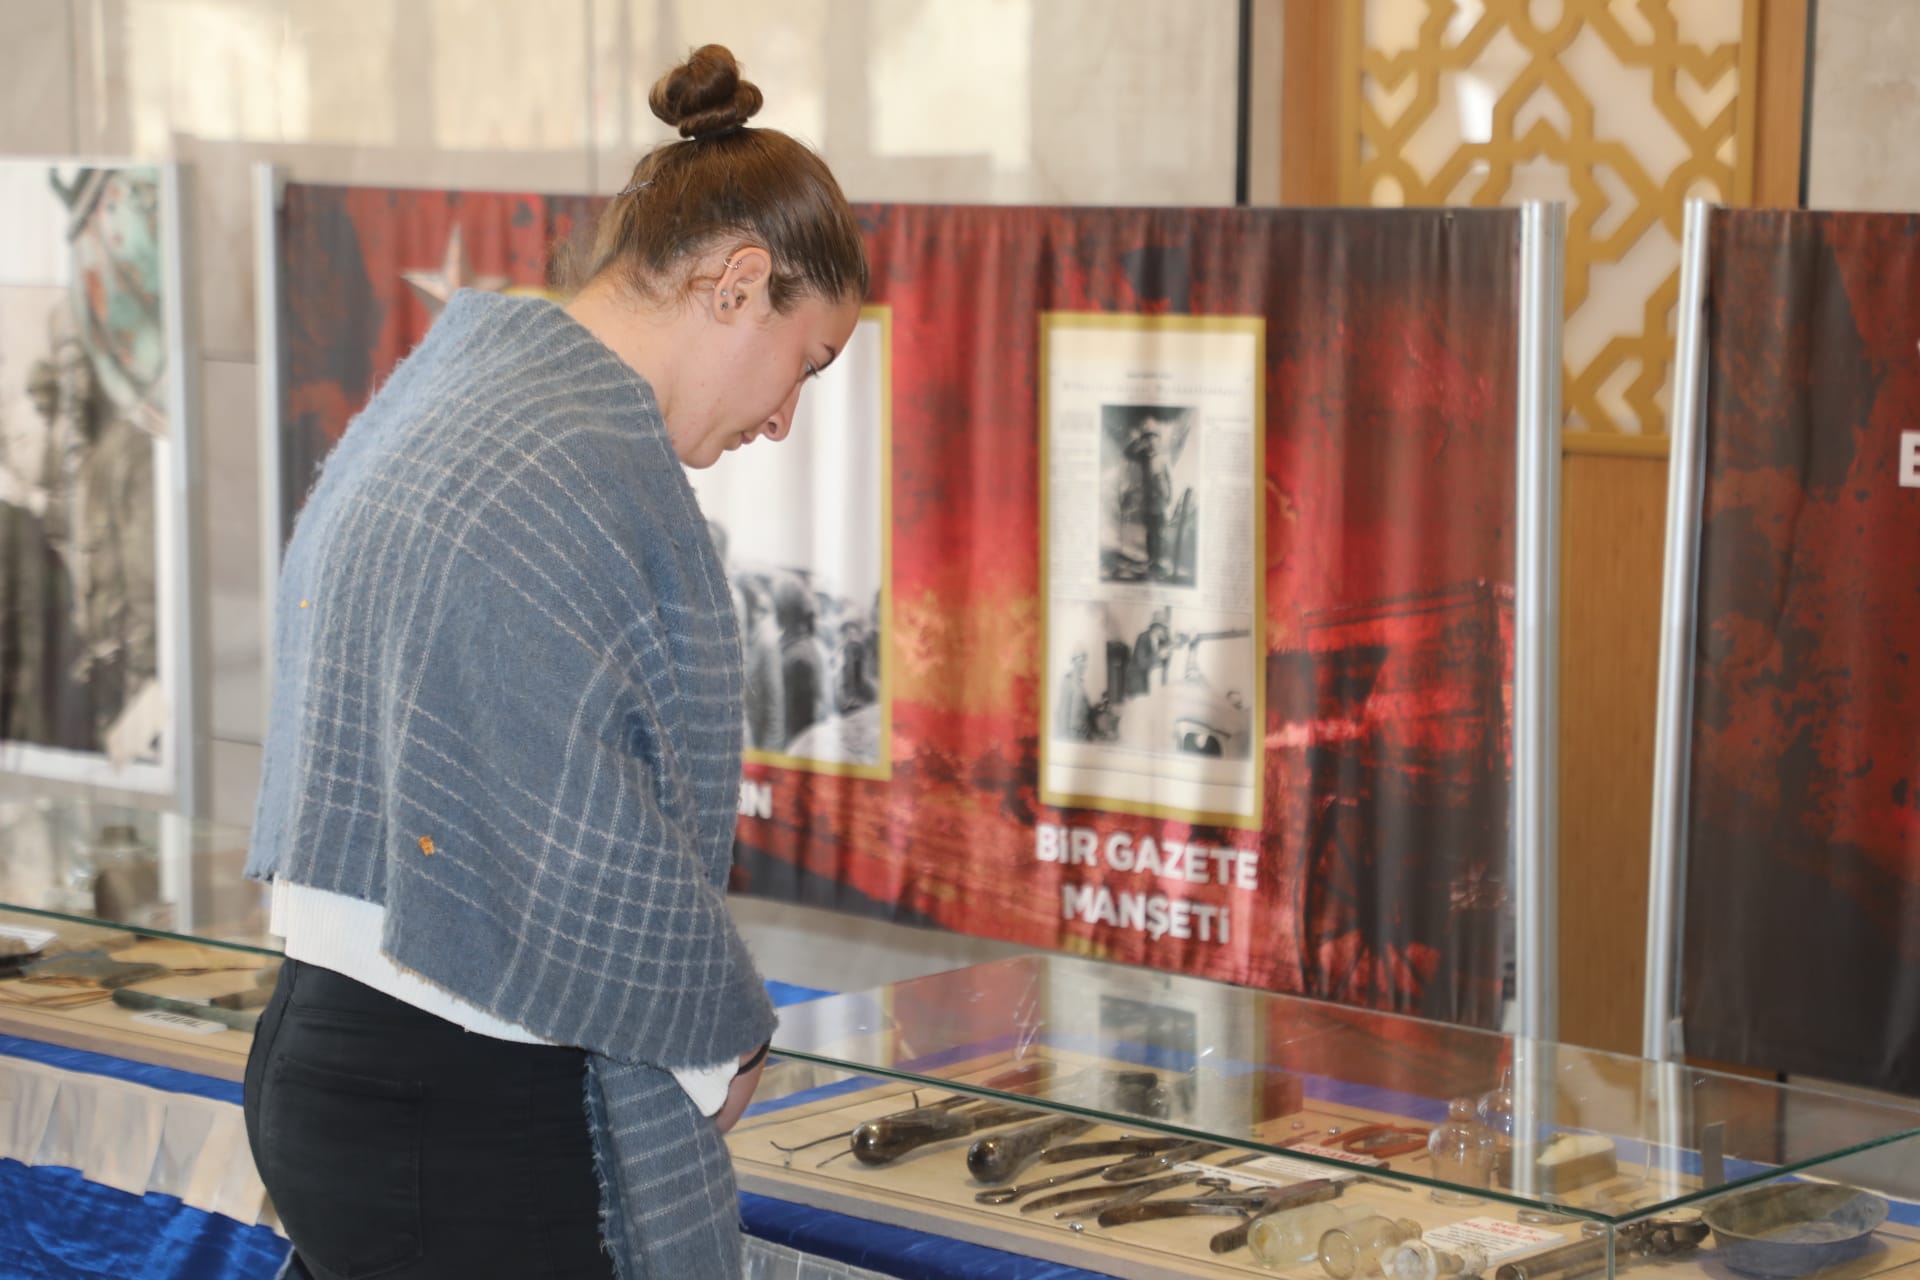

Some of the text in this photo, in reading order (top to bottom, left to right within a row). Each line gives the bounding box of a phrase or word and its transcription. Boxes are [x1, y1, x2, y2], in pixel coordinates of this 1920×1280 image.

[1036, 824, 1258, 889] BİR GAZETE
[1063, 885, 1228, 943] MANŞETİ
